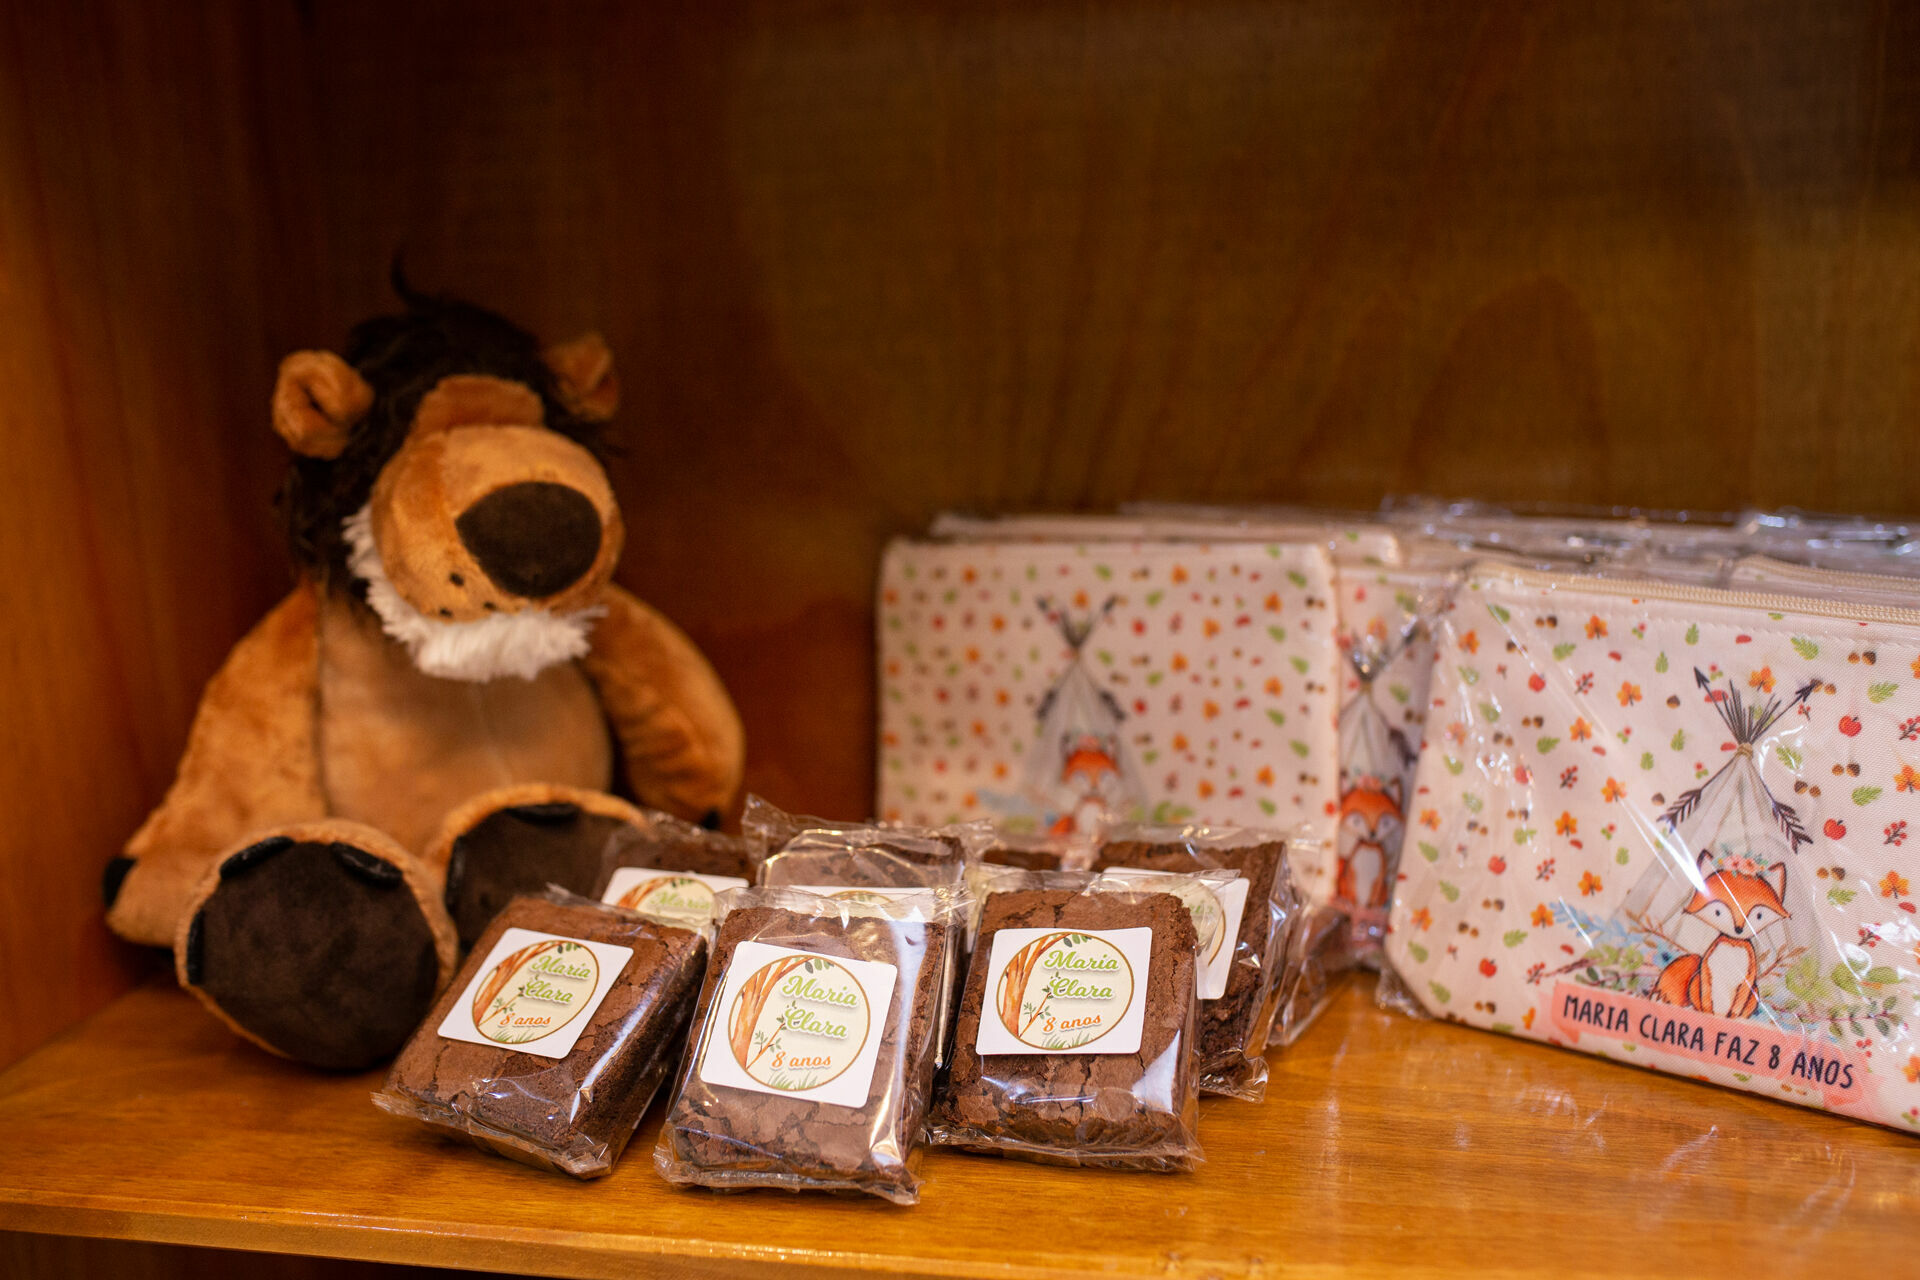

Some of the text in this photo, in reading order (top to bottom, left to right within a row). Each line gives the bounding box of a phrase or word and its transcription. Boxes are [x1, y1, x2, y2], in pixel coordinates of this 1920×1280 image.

[531, 955, 592, 979] Maria
[1044, 949, 1119, 971] Maria
[525, 980, 573, 1003] Clara
[782, 975, 859, 1007] Maria
[1049, 977, 1114, 998] Clara
[499, 1013, 552, 1026] 8 anos
[784, 1008, 848, 1038] Clara
[1043, 1014, 1102, 1033] 8 anos
[1562, 994, 1855, 1090] MARIA CLARA FAZ 8 ANOS
[771, 1051, 832, 1069] 8 anos
